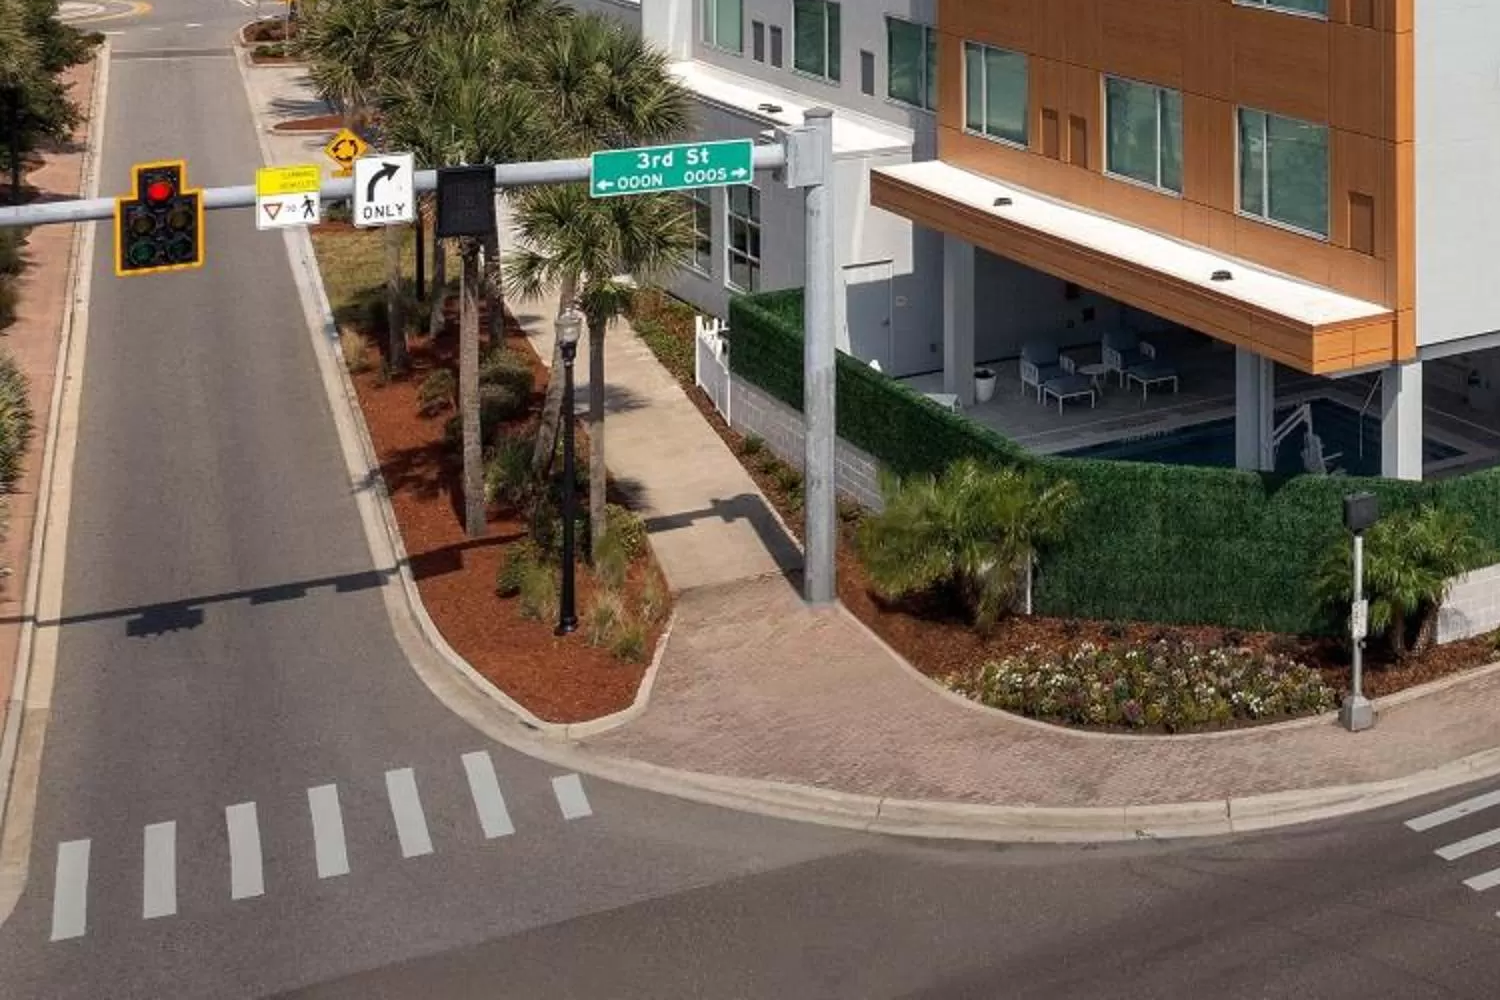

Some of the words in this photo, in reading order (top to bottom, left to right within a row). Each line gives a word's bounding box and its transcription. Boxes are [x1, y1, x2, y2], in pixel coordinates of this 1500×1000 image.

[637, 150, 673, 169] 3rd
[686, 147, 710, 165] St
[617, 173, 663, 190] 000N
[683, 167, 727, 183] 000S
[363, 202, 405, 220] ONLY
